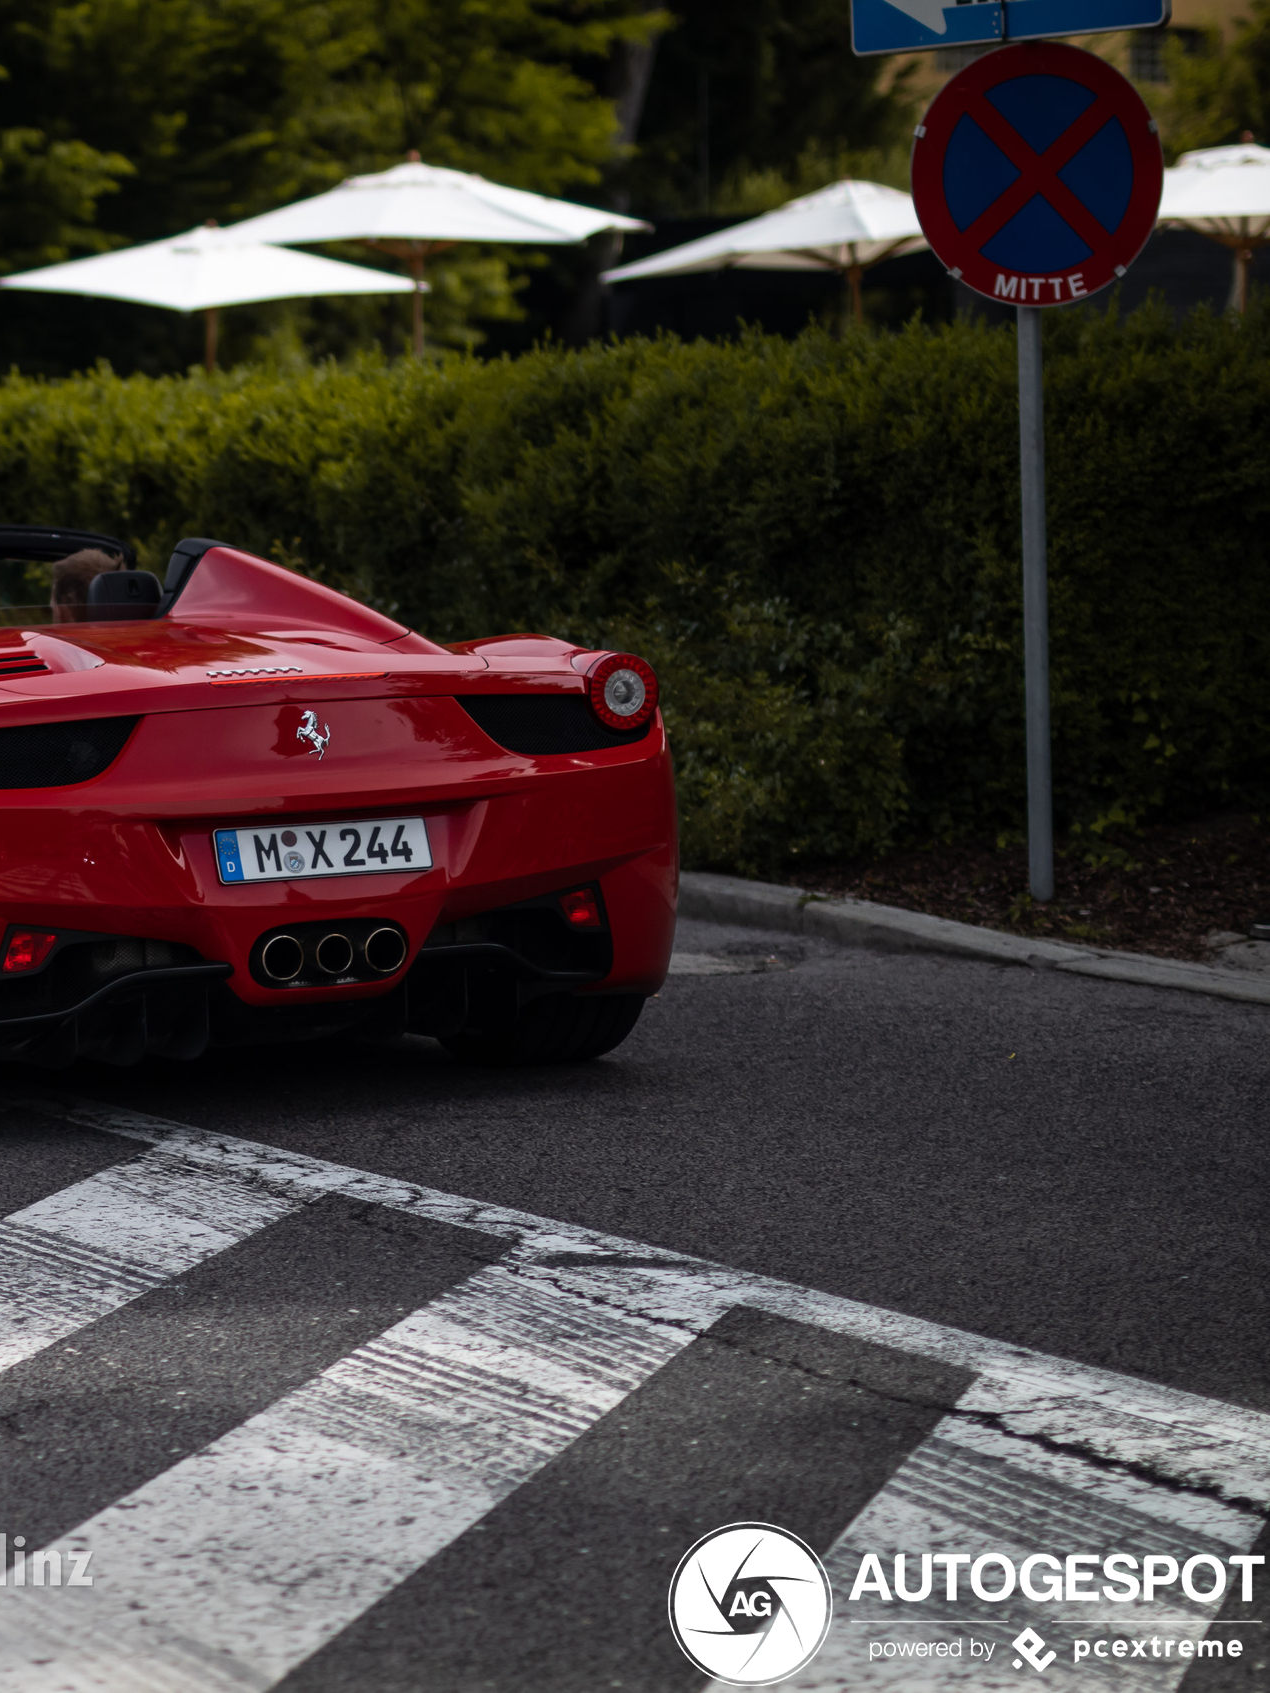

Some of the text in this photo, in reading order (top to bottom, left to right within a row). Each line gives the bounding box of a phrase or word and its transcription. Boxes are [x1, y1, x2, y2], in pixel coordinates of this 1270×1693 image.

[994, 273, 1088, 300] MITTE
[253, 834, 282, 873] M
[305, 830, 334, 869] X
[339, 825, 413, 867] 244
[226, 861, 236, 873] D
